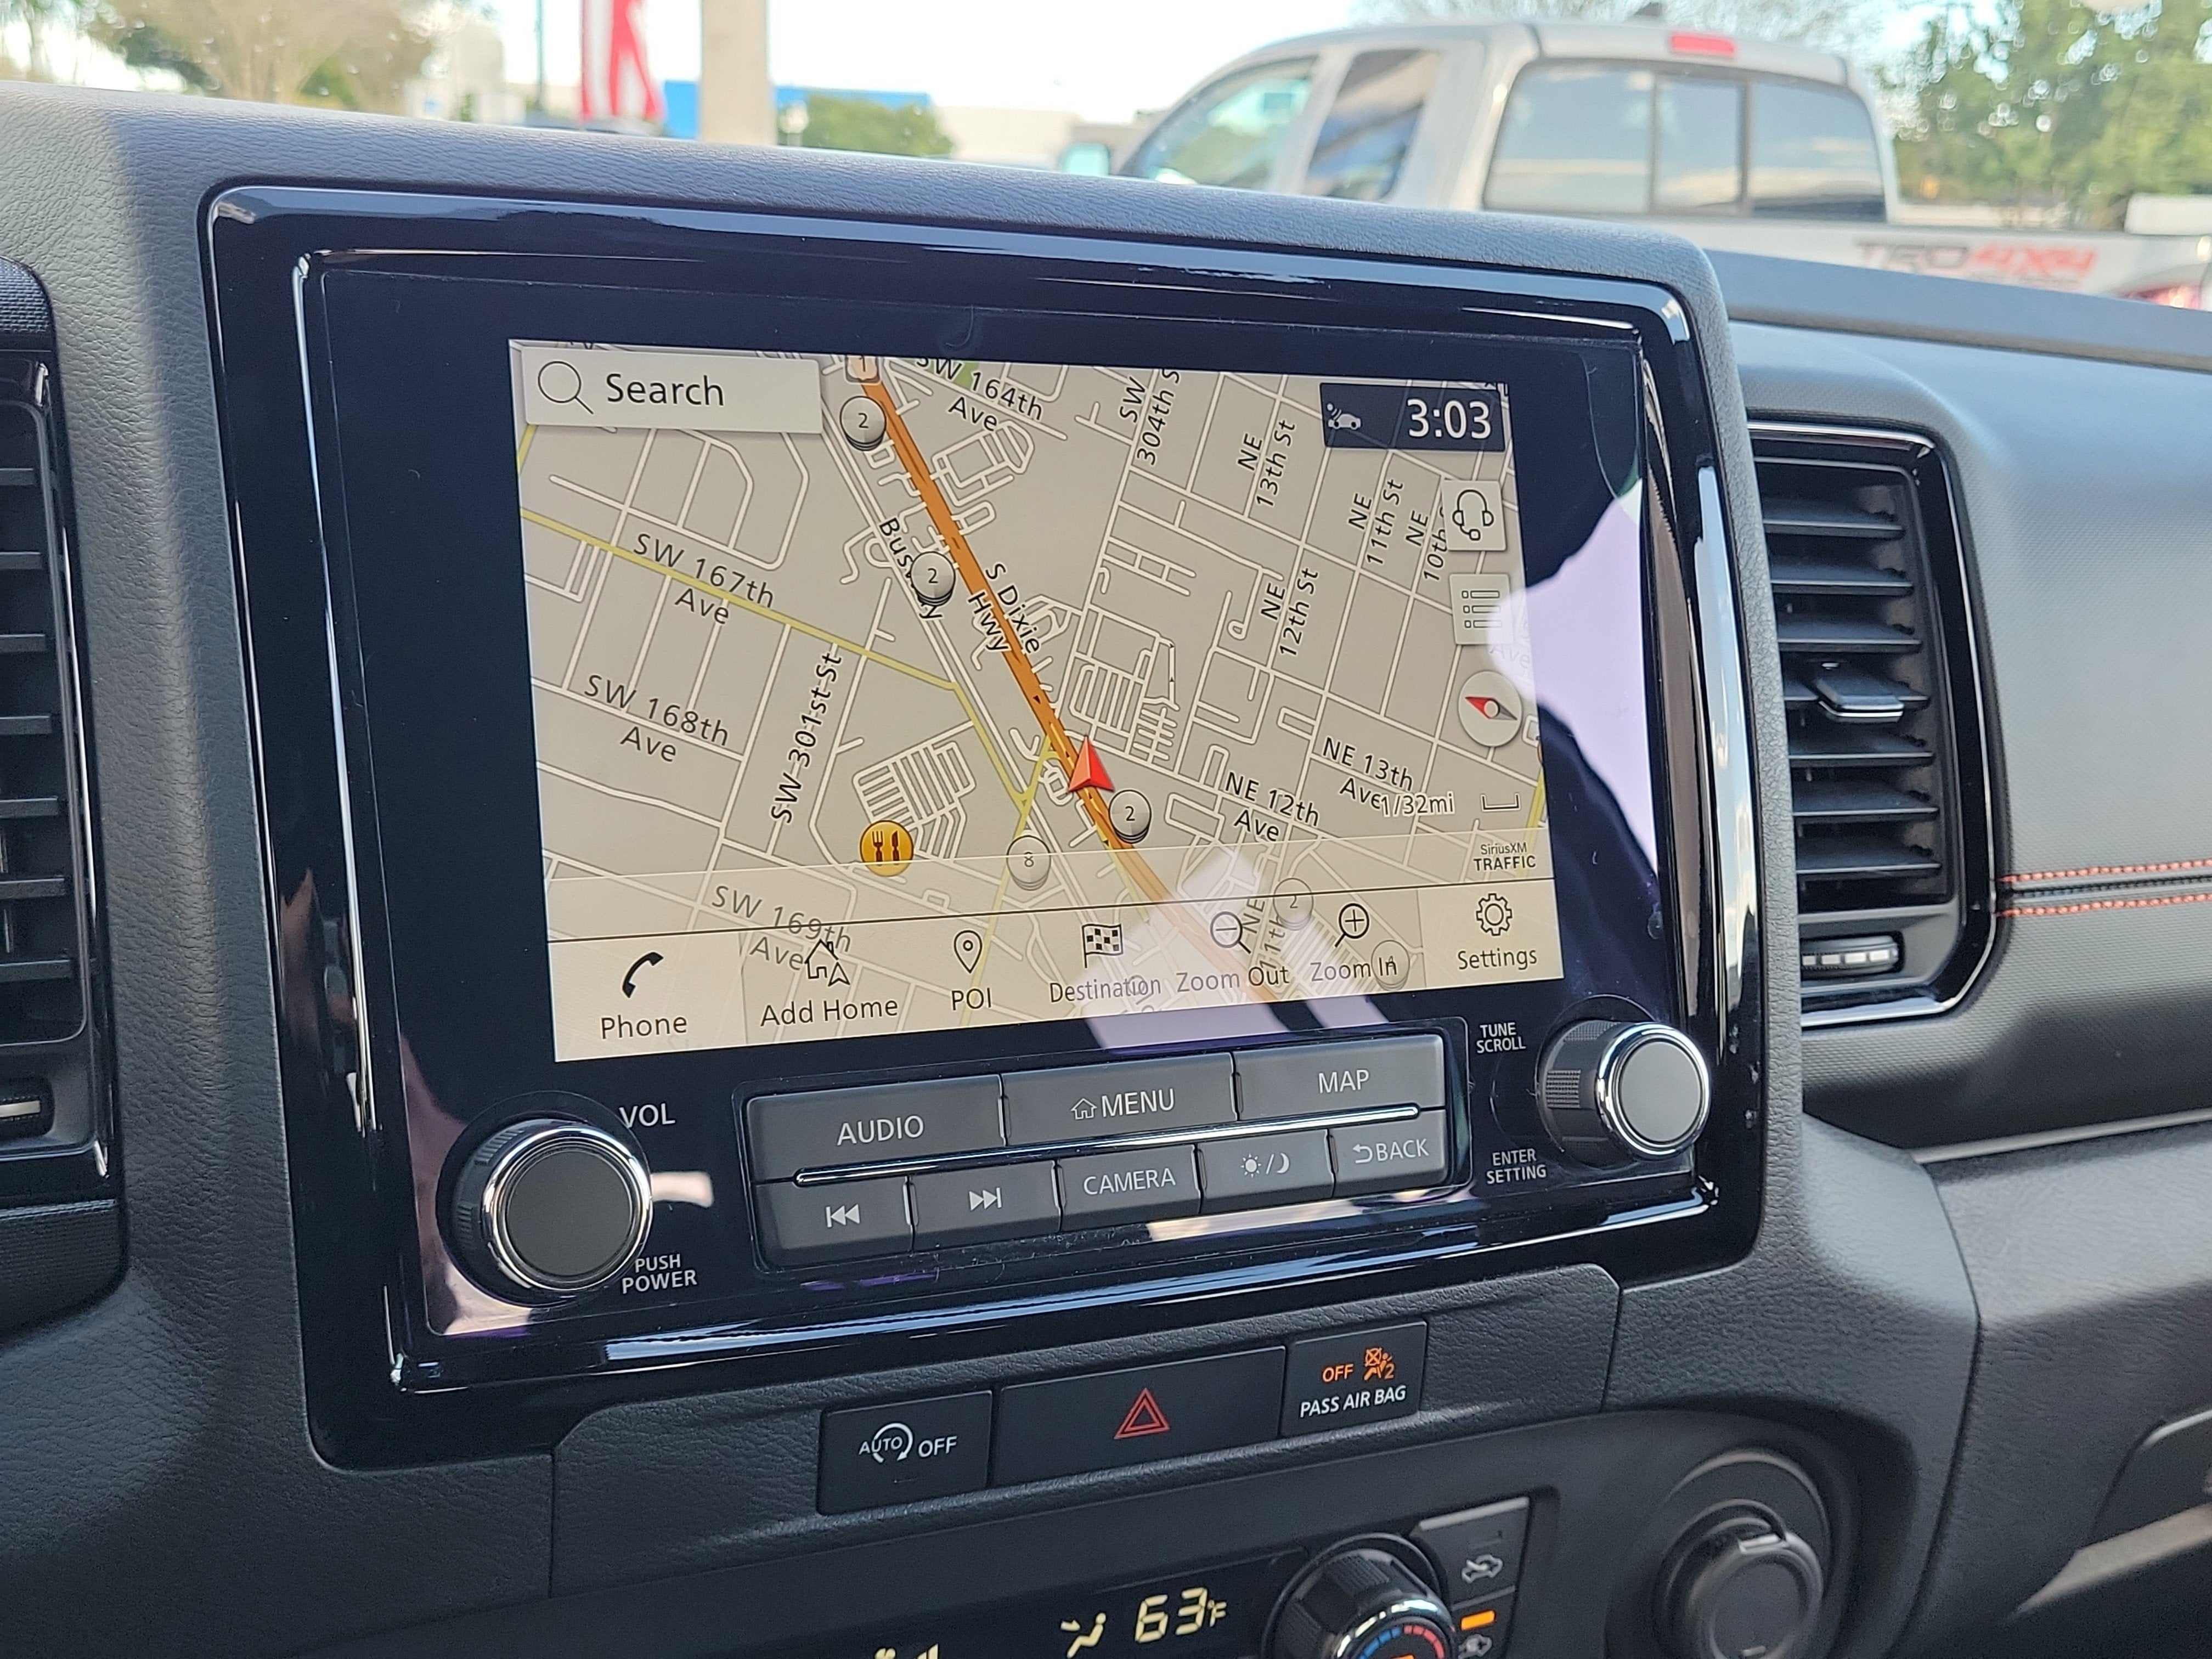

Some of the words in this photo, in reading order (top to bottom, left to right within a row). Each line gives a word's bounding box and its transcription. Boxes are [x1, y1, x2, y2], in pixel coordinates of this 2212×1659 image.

[607, 373, 724, 407] Search
[972, 373, 1042, 421] 164th
[1119, 376, 1146, 423] SW
[857, 413, 869, 428] 2
[948, 397, 997, 431] Ave
[1137, 390, 1175, 465] 304th
[1407, 399, 1491, 439] 3:03
[1238, 433, 1262, 470] NE
[1256, 452, 1286, 507] 13th
[1274, 420, 1295, 446] St
[1348, 493, 1372, 529] NE
[1368, 513, 1396, 565] 11th
[1384, 479, 1403, 506] St
[1406, 510, 1428, 546] NE
[634, 533, 684, 568] SW
[695, 558, 774, 608] 167th
[879, 517, 943, 619] Busy
[928, 568, 938, 583] 2
[675, 588, 729, 625] Ave
[985, 563, 1006, 580] S
[998, 584, 1040, 653] Dixie
[1261, 583, 1285, 620] NE
[1280, 601, 1310, 656] 12th
[1297, 568, 1318, 593] St
[967, 591, 1009, 653] Hwy
[584, 675, 636, 709] SW
[648, 697, 729, 746] 168th
[620, 726, 677, 763] Ave
[771, 772, 803, 823] SW
[788, 686, 832, 768] 301st
[816, 652, 842, 682] St
[1322, 737, 1356, 766] NE
[1364, 755, 1413, 791] 13th
[1226, 772, 1260, 802] NE
[1268, 789, 1319, 827] 12th
[1340, 778, 1380, 809] Ave
[1381, 793, 1454, 816] 1/32mi
[1125, 805, 1136, 822] 2
[1234, 810, 1280, 842] Ave
[1474, 856, 1537, 872] TRAFFIC
[1481, 842, 1527, 855] SiriusXM
[712, 885, 762, 919] SW
[772, 905, 851, 952] 169th
[749, 937, 805, 971] Ave
[1311, 959, 1371, 982] Zoom
[1379, 957, 1397, 976] In
[1458, 948, 1537, 972] Settings
[1049, 977, 1161, 1003] Destination
[1176, 971, 1240, 992] Zoom
[1249, 966, 1289, 987] Out
[761, 1000, 812, 1028] Add
[824, 998, 899, 1022] Home
[951, 988, 992, 1011] POI
[601, 1014, 688, 1039] Phone
[1480, 1022, 1517, 1039] TUNE
[1476, 1036, 1526, 1054] SCROLL
[1318, 1069, 1370, 1095] MAP
[619, 1103, 675, 1129] VOL
[1102, 1088, 1175, 1118] MENU
[837, 1115, 924, 1146] AUDIO
[1376, 1139, 1429, 1163] BACK
[1492, 1148, 1537, 1166] ENTER
[1084, 1167, 1176, 1195] CAMERA
[1486, 1164, 1547, 1185] SETTING
[635, 1254, 680, 1273] PUSH
[622, 1270, 697, 1294] POWER
[1322, 1363, 1353, 1383] OFF
[1300, 1396, 1340, 1418] PASS
[1343, 1391, 1370, 1410] AIR
[1375, 1384, 1406, 1406] BAG
[858, 1435, 903, 1455] AUTO
[918, 1436, 957, 1459] OFF
